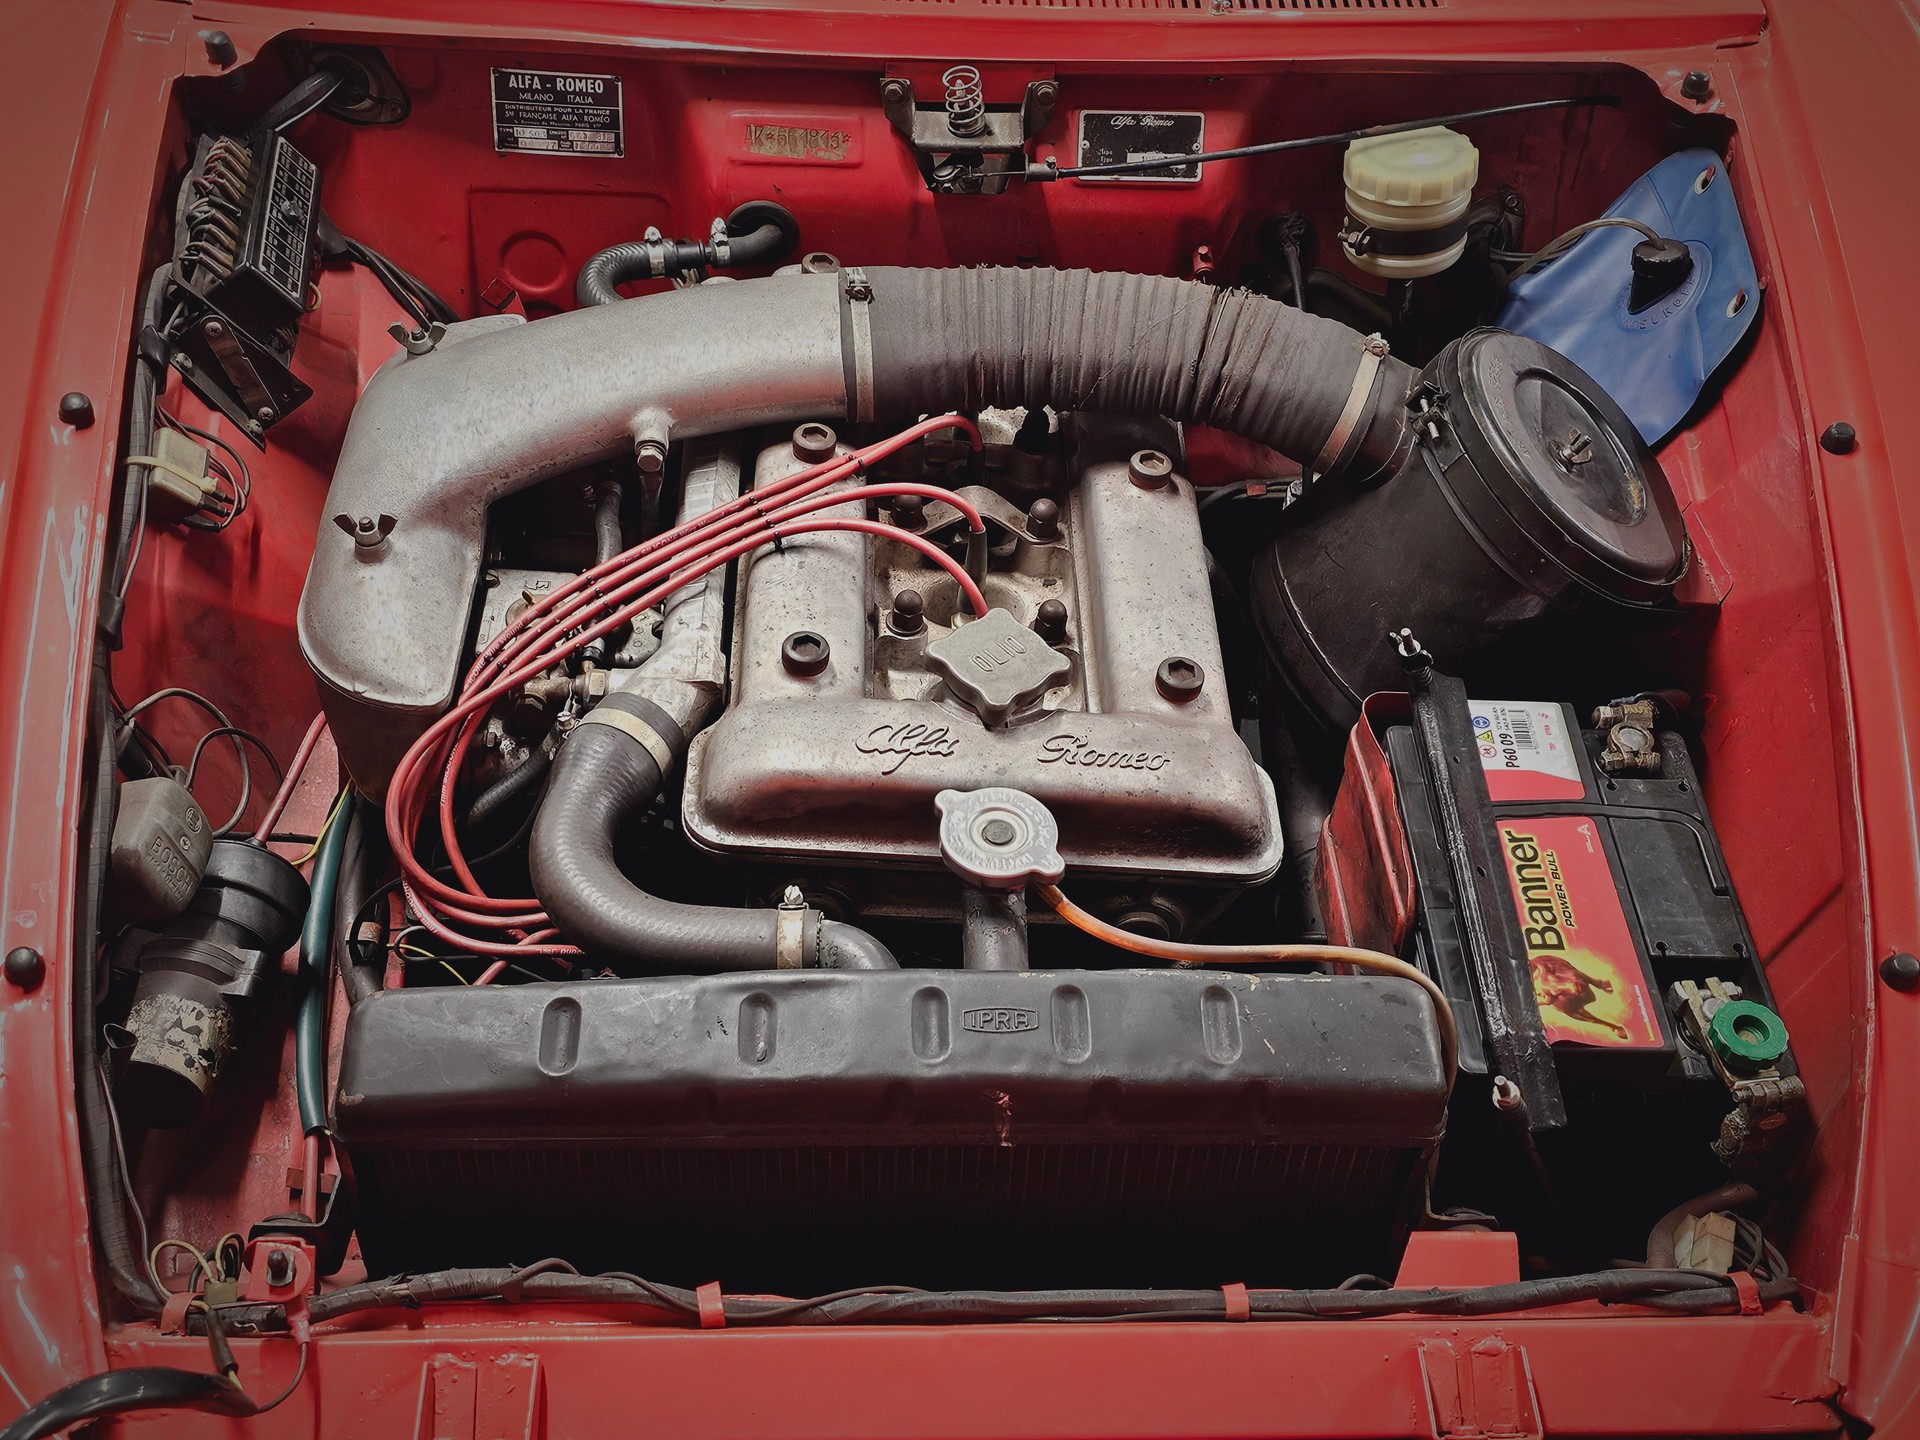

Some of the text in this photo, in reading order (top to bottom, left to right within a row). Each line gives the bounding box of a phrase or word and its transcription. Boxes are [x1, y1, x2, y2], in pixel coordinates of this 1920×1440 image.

[508, 74, 542, 90] ALFA
[556, 77, 604, 94] ROMEO
[518, 92, 594, 104] MILANO ITALIA
[504, 104, 552, 112] DISTRIBUTEUR
[1110, 115, 1175, 130] Alfa Romeo
[972, 635, 1027, 672] OLIO
[854, 723, 1171, 776] Alfa Romeo
[1498, 733, 1520, 768] P60 09
[151, 836, 195, 895] BOSCH
[1504, 829, 1566, 951] Banner
[1549, 850, 1576, 928] POWER BULL
